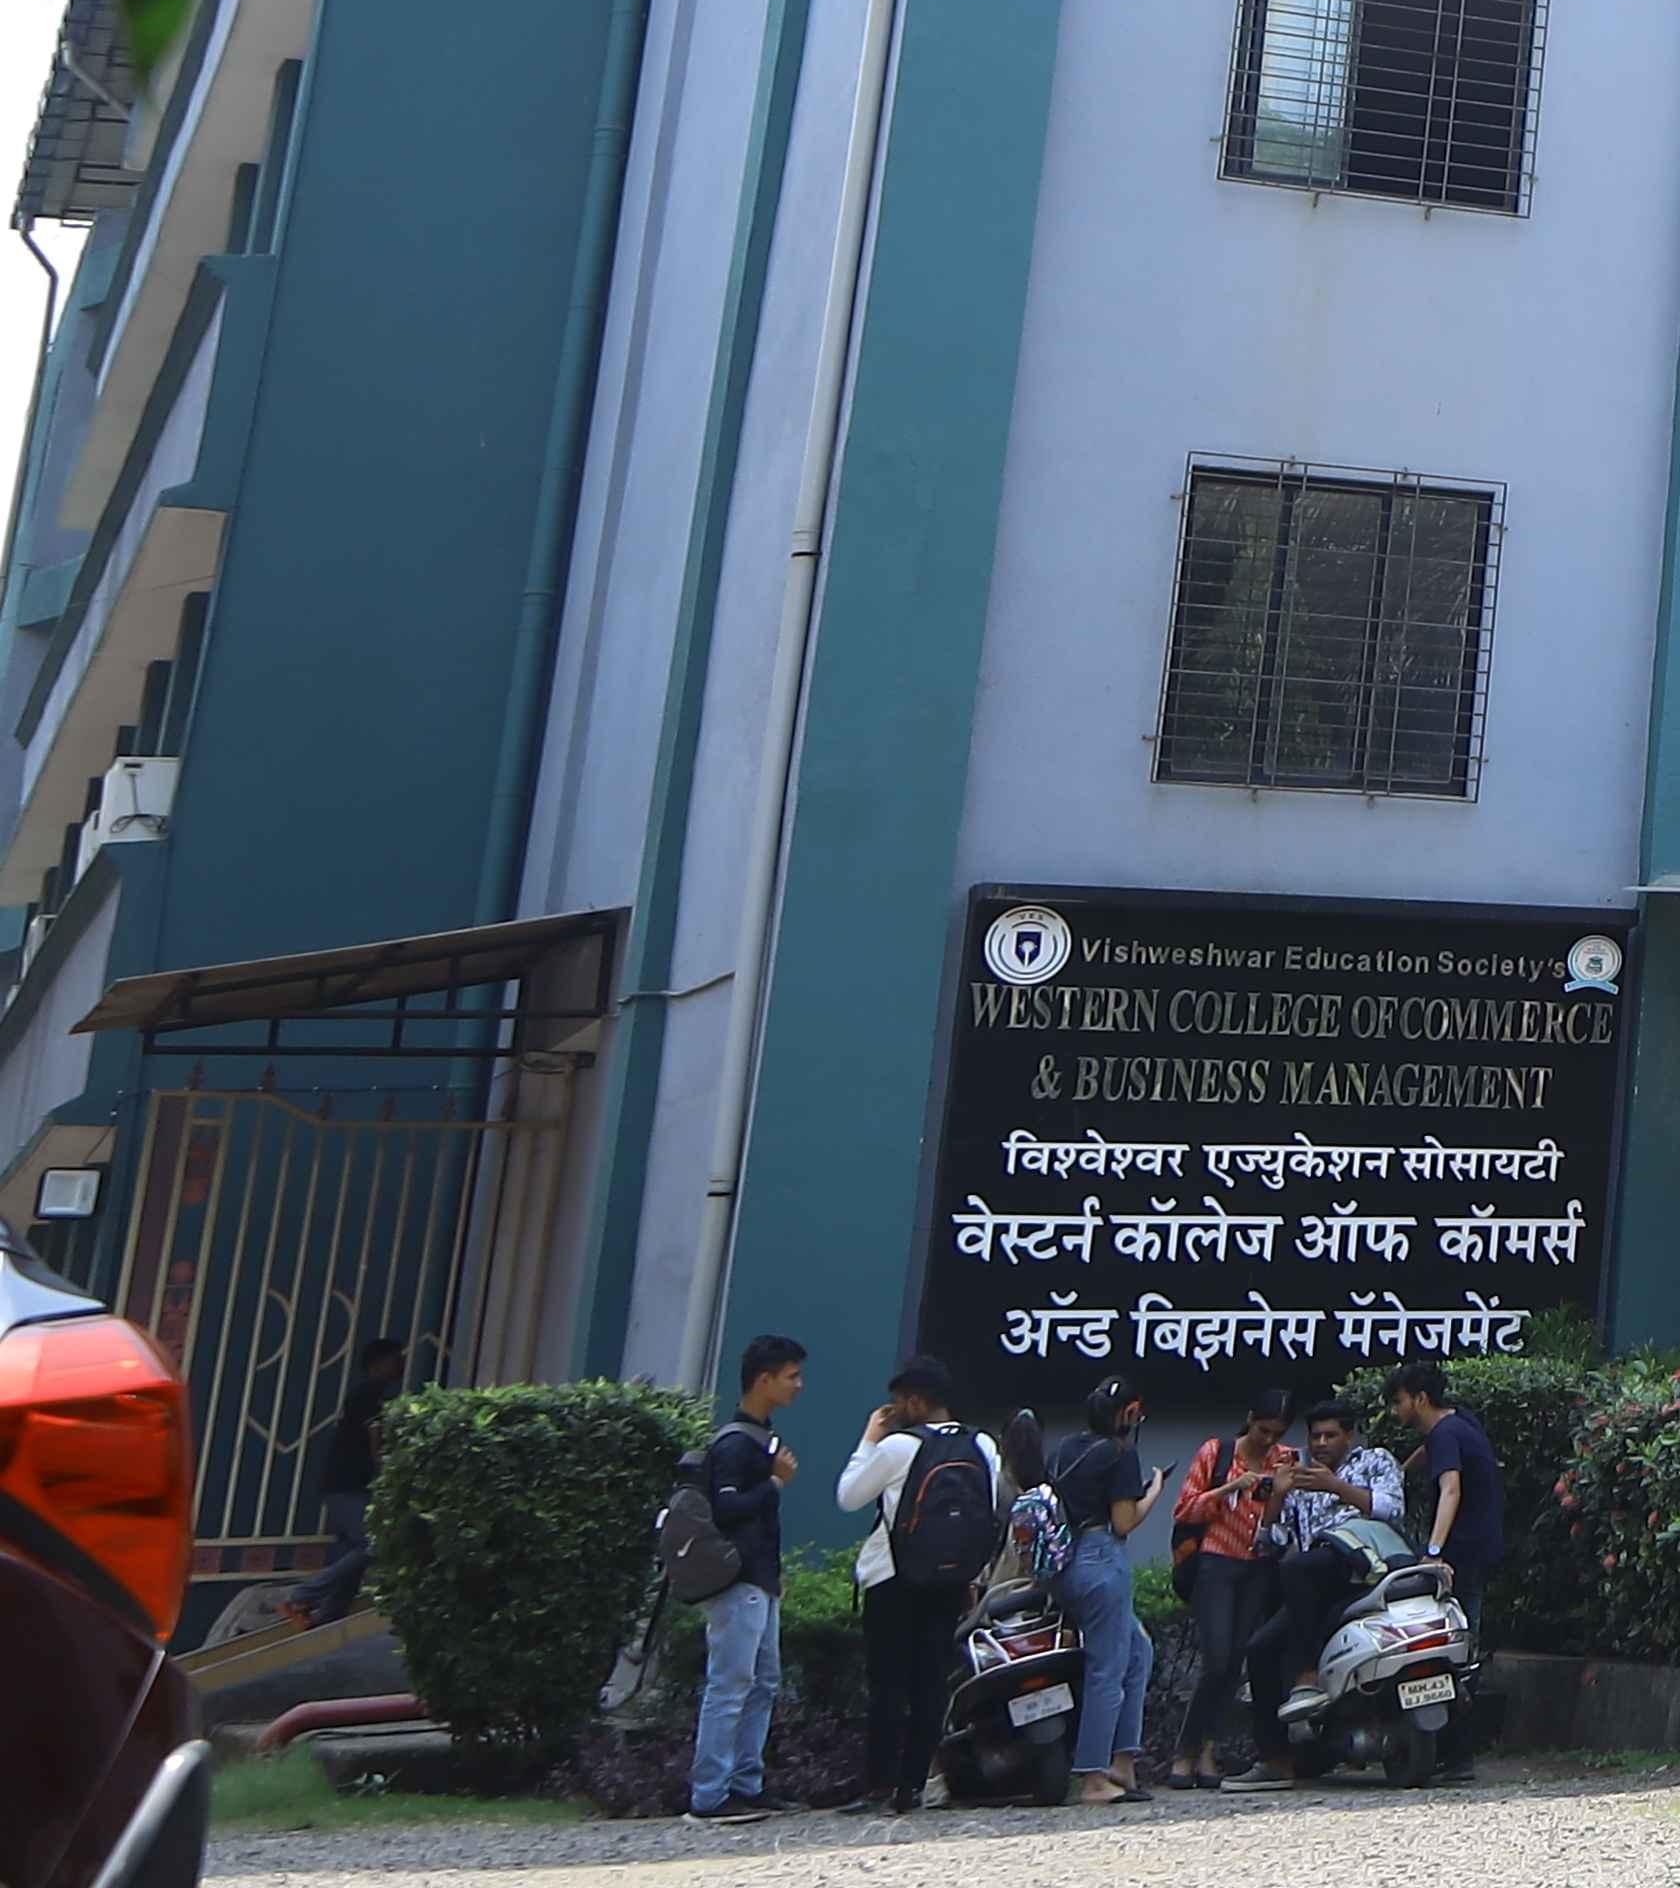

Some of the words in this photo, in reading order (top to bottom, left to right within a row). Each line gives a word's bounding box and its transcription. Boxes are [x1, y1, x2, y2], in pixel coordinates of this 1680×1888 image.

[1082, 938, 1275, 969] Vishweshwar
[1285, 946, 1429, 973] Education
[1437, 950, 1566, 983] Society's
[970, 982, 1160, 1033] WESTERN
[1169, 988, 1343, 1038] COLLEGE
[1400, 996, 1615, 1044] COMMERCE
[1031, 1055, 1062, 1100] &
[1073, 1057, 1270, 1104] BUSINESS
[1280, 1061, 1553, 1110] MANAGEMENT
[1002, 1129, 1189, 1181] विश्वेश्वर
[1203, 1130, 1394, 1189] एज्युकेशन
[1401, 1135, 1564, 1183] सोसायटी
[953, 1195, 1103, 1264] वेस्टर्न
[1109, 1196, 1283, 1264] कॉलेज
[1296, 1200, 1416, 1264] ऑफ
[1436, 1199, 1586, 1265] कॉमर्स
[1130, 1291, 1326, 1371] बिझनेस
